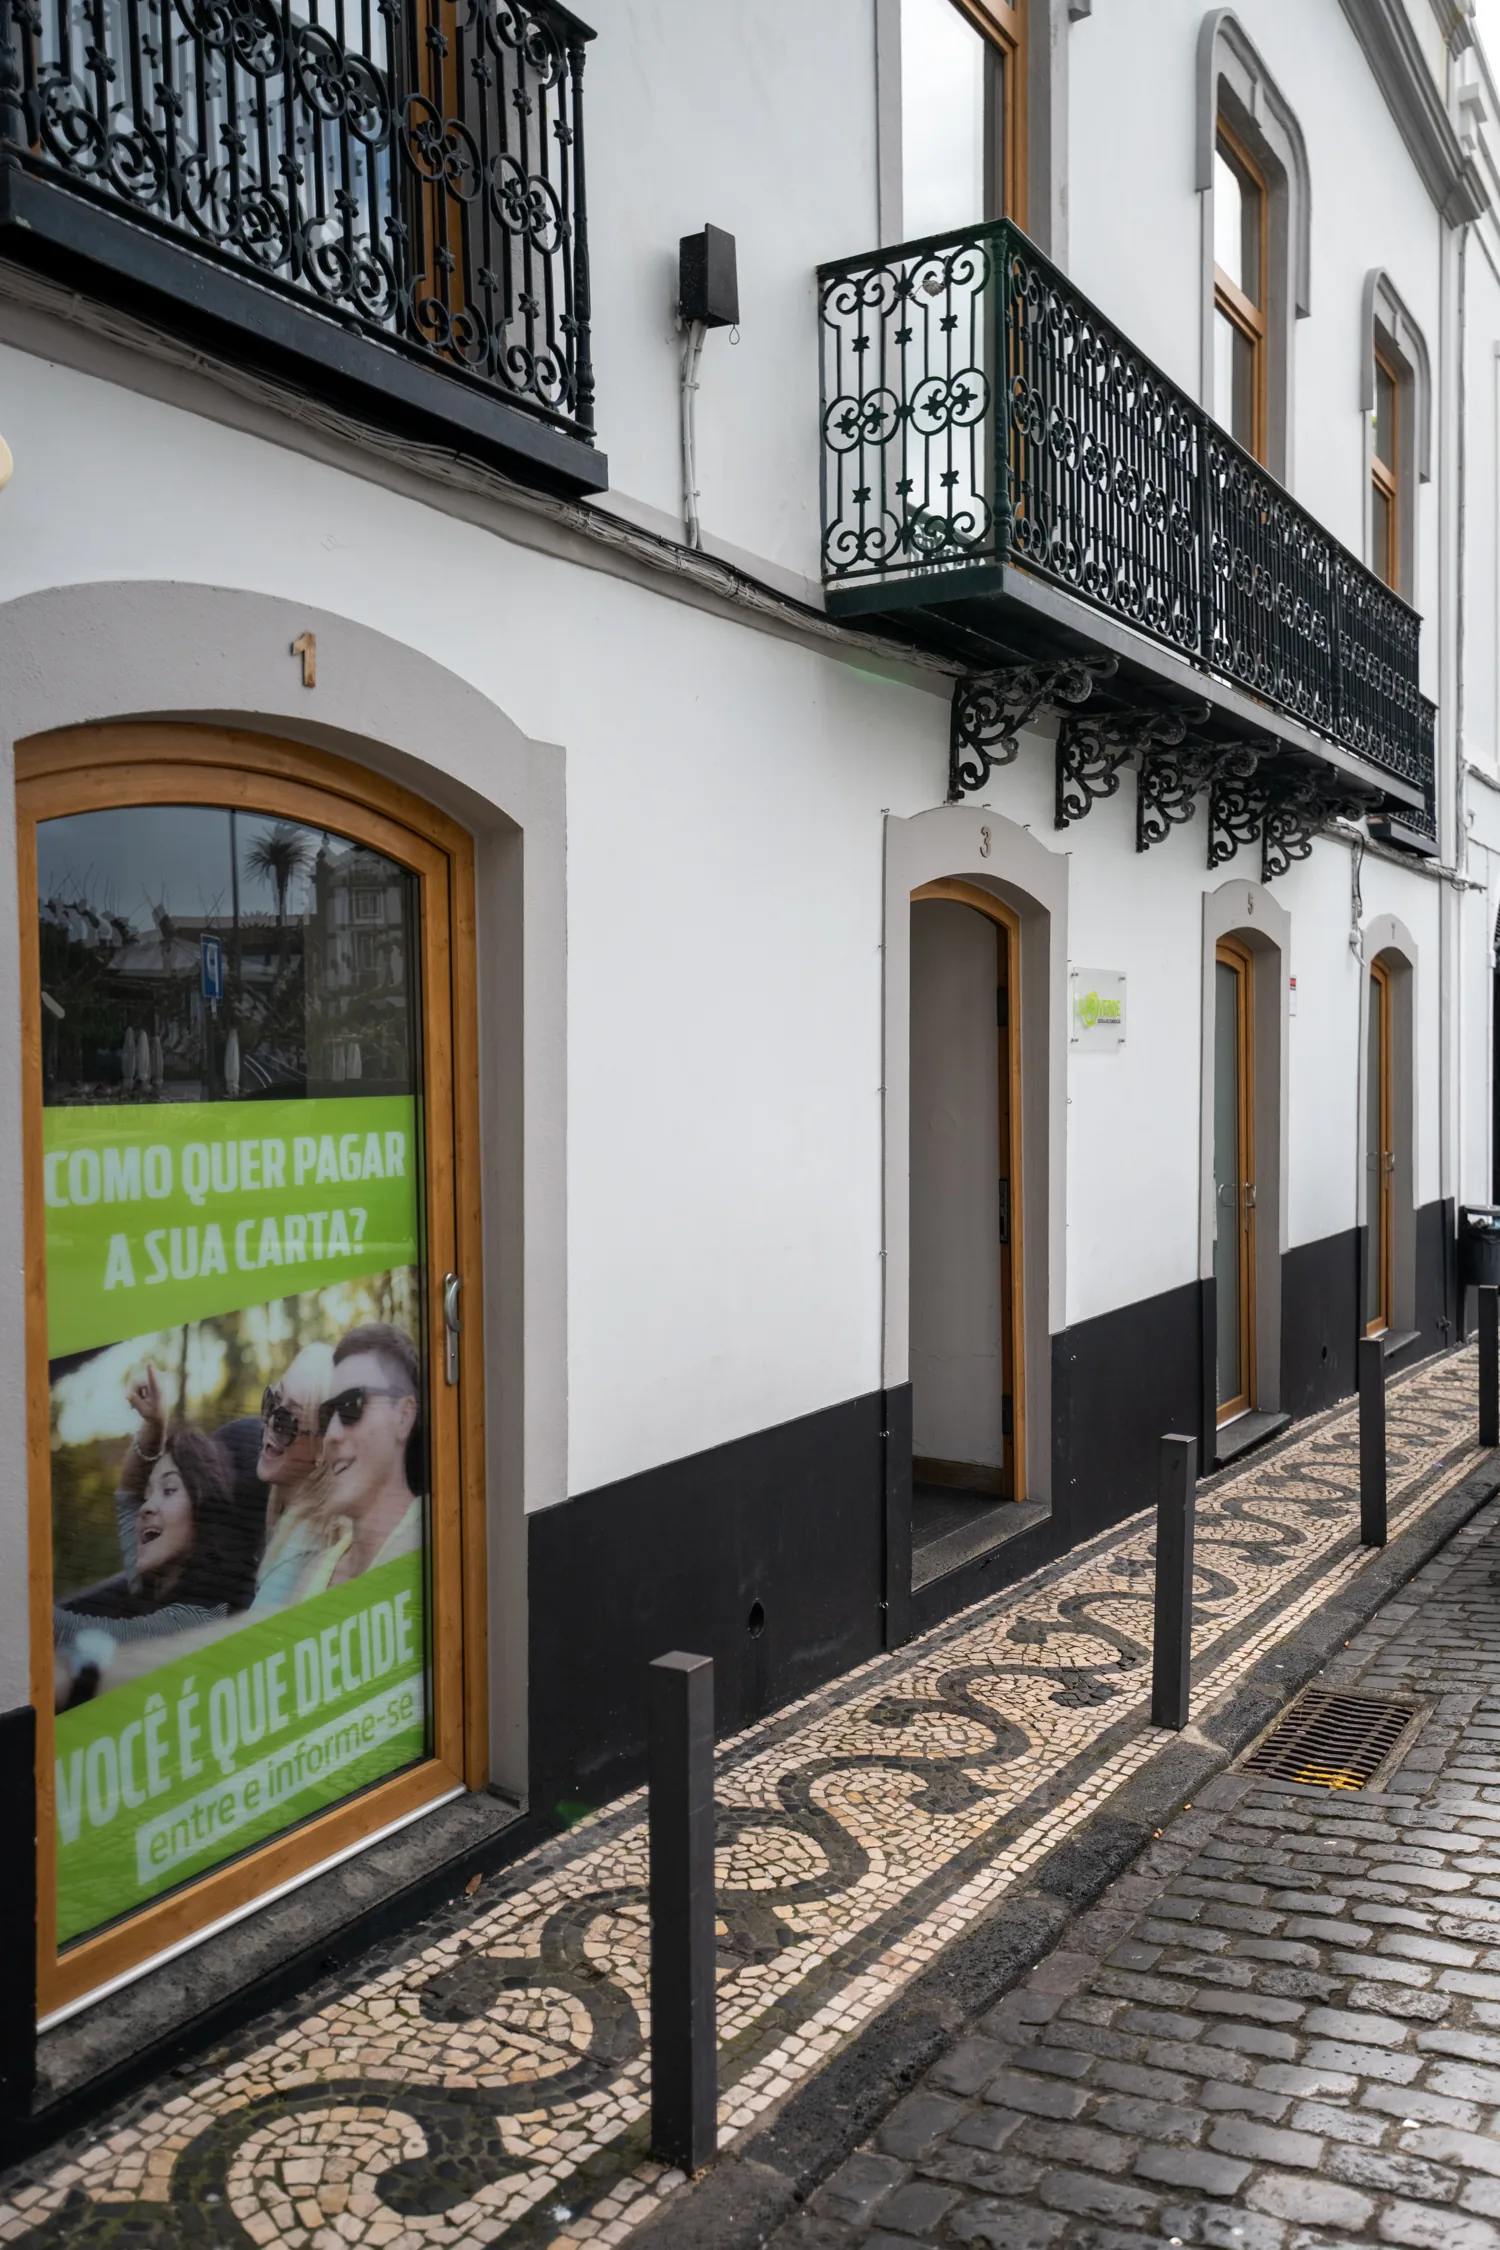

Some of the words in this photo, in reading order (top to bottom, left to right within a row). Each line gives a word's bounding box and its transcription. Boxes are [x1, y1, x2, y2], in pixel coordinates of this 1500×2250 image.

[289, 632, 317, 688] 1
[980, 826, 992, 858] 3
[1247, 891, 1254, 915] 5
[44, 1144, 173, 1207] COMO
[181, 1137, 286, 1205] QUER
[293, 1131, 406, 1186] PAGAR
[103, 1233, 136, 1290] A
[144, 1223, 228, 1284] SUA
[234, 1207, 368, 1270] CARTA?
[55, 1692, 171, 1847] VOCÊ
[176, 1675, 204, 1781] É
[208, 1651, 290, 1774] QUE
[294, 1590, 415, 1718] DECIDE
[149, 1799, 236, 1866] entre
[243, 1778, 260, 1811] e
[268, 1690, 415, 1793] informe-se
